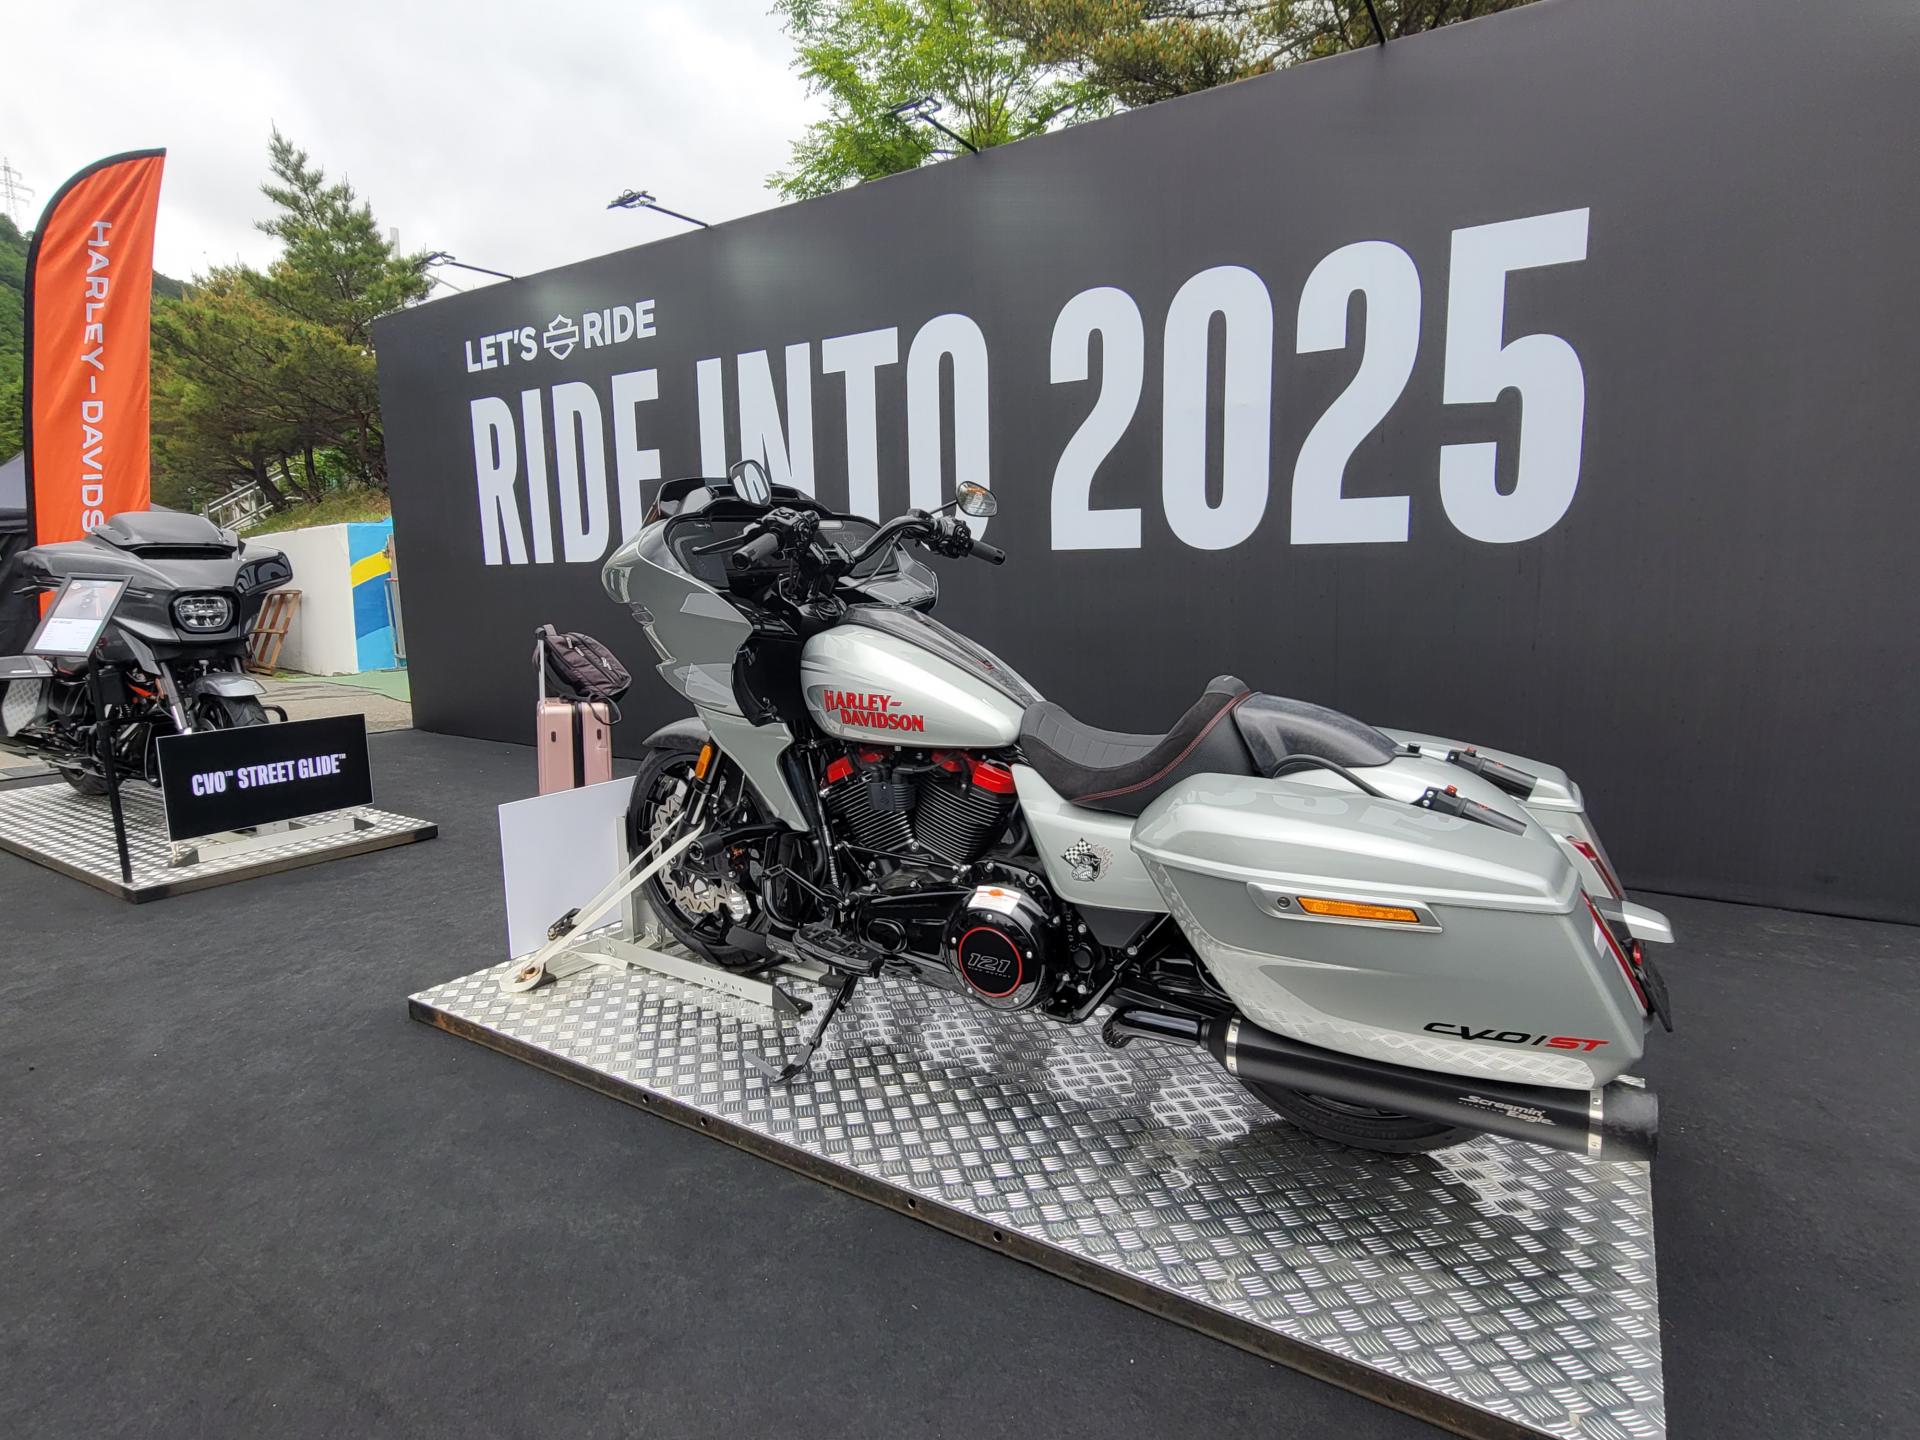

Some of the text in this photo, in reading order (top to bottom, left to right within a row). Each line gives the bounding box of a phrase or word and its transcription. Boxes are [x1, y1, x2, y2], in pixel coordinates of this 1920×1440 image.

[465, 298, 657, 373] LET'S RIDE
[470, 207, 1590, 566] RIDE INTO 2025
[840, 708, 925, 732] DAVIDSON
[237, 760, 296, 789] STREET
[967, 952, 1011, 974] 121
[1506, 1110, 1557, 1126] Eagle
